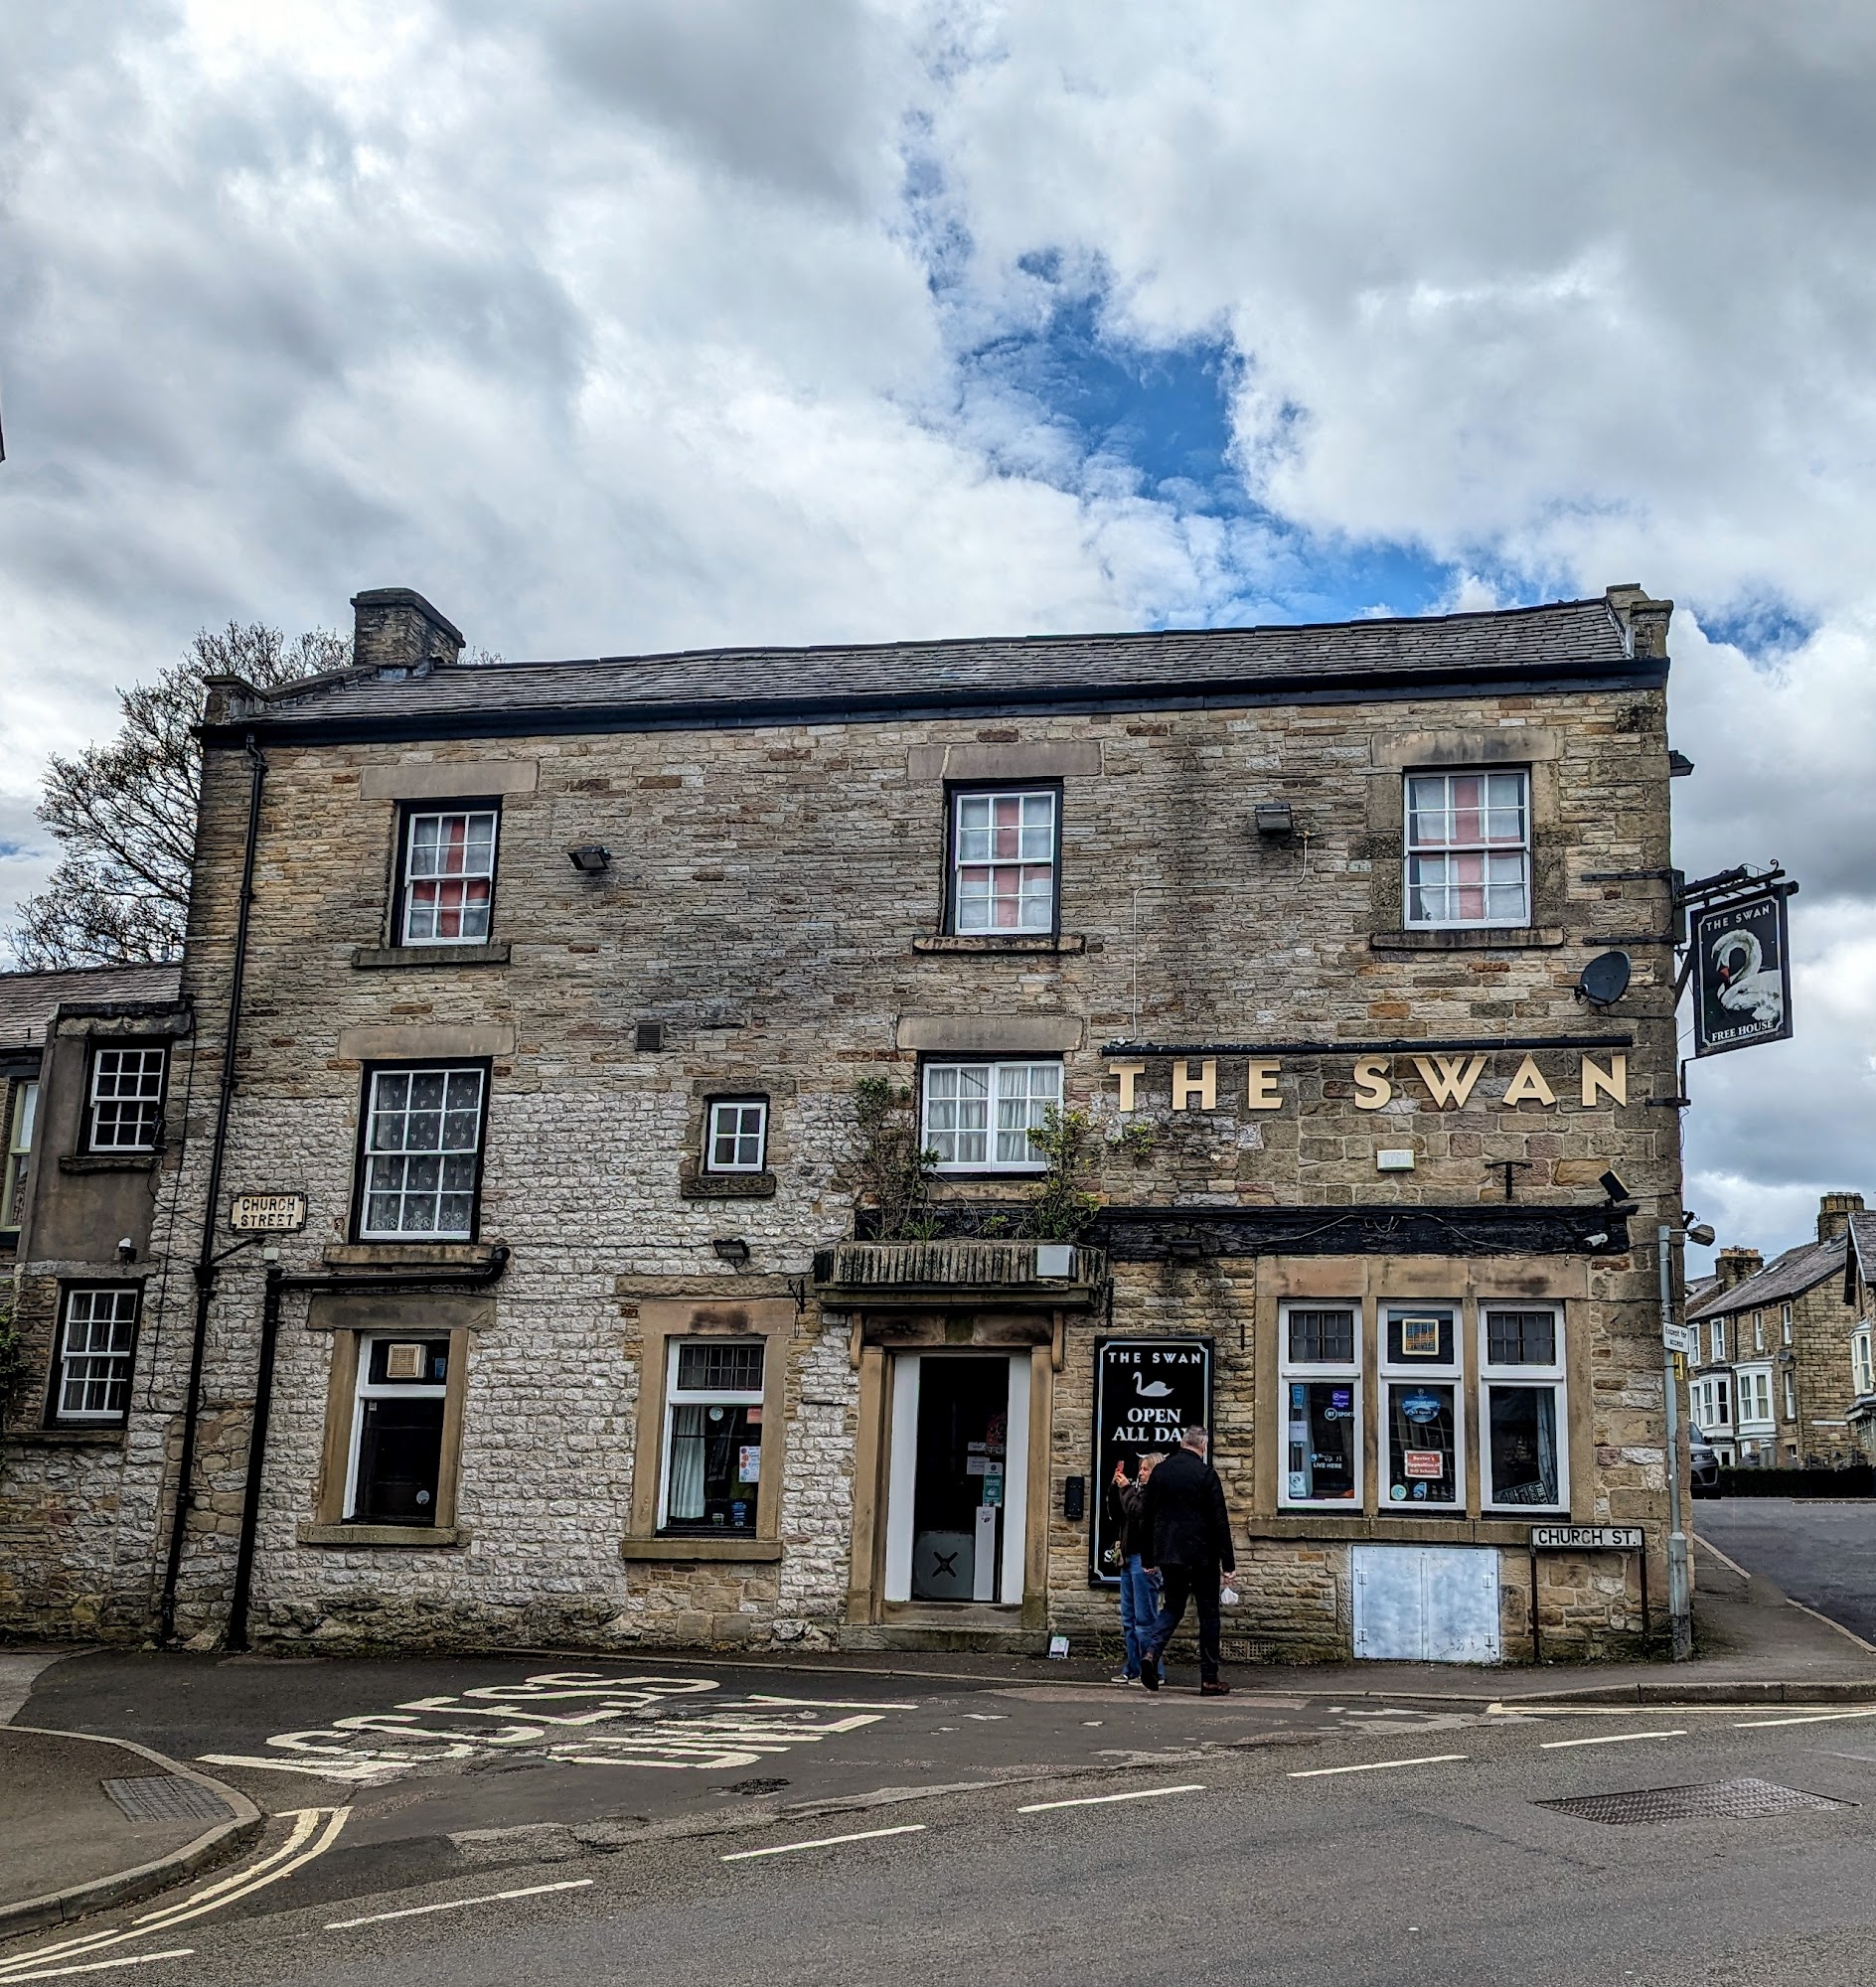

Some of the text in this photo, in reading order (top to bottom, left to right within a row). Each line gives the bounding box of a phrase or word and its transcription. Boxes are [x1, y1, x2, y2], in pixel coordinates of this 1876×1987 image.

[1706, 905, 1770, 932] THE SWAN
[1711, 1018, 1774, 1042] FREE HOUSE
[1108, 1053, 1628, 1113] THE SWAN
[241, 1197, 295, 1211] CHURCH
[240, 1213, 295, 1227] STREET
[1664, 1325, 1680, 1337] Except
[1669, 1338, 1684, 1348] access
[1108, 1352, 1201, 1364] THE SWAN
[1127, 1407, 1182, 1423] OPEN
[1111, 1426, 1187, 1443] ALL DA
[1535, 1481, 1546, 1498] THE
[1538, 1529, 1637, 1545] CHURCH ST.
[196, 1672, 720, 1779] ACCESS
[546, 1694, 919, 1769] ONLY
